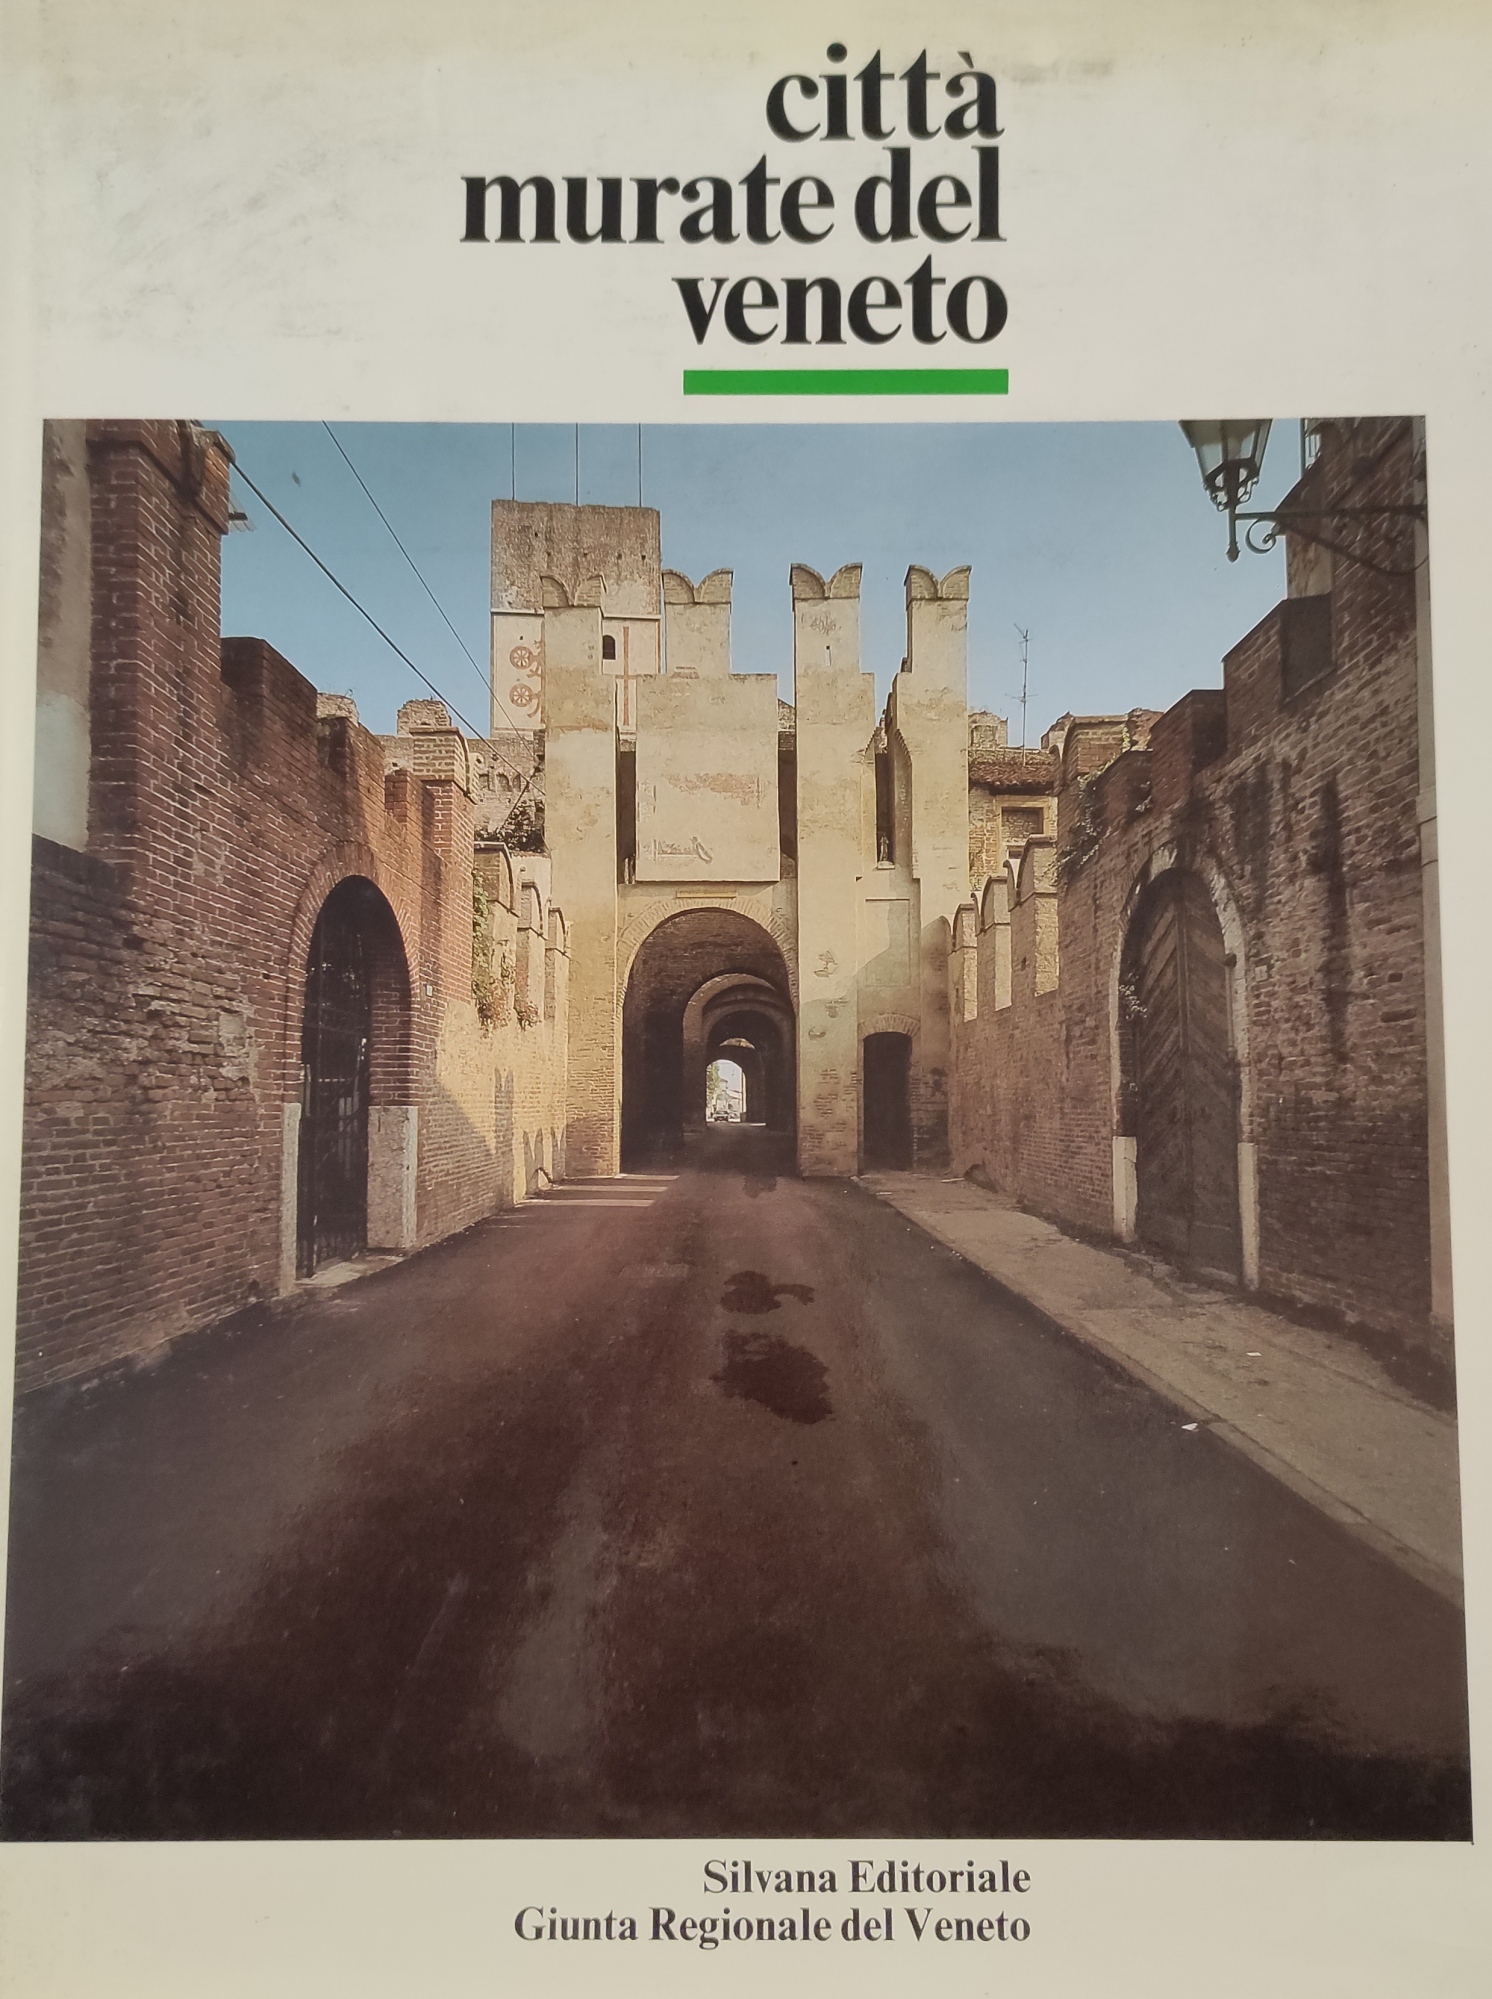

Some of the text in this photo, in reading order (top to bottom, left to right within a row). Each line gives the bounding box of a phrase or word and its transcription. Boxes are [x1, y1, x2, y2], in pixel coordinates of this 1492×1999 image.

[766, 42, 1005, 142] città
[459, 145, 1007, 244] murate del
[672, 253, 1009, 345] veneto
[703, 1859, 1031, 1894] Silvana Editoriale
[514, 1906, 1031, 1951] Giunta Regionale del Veneto
